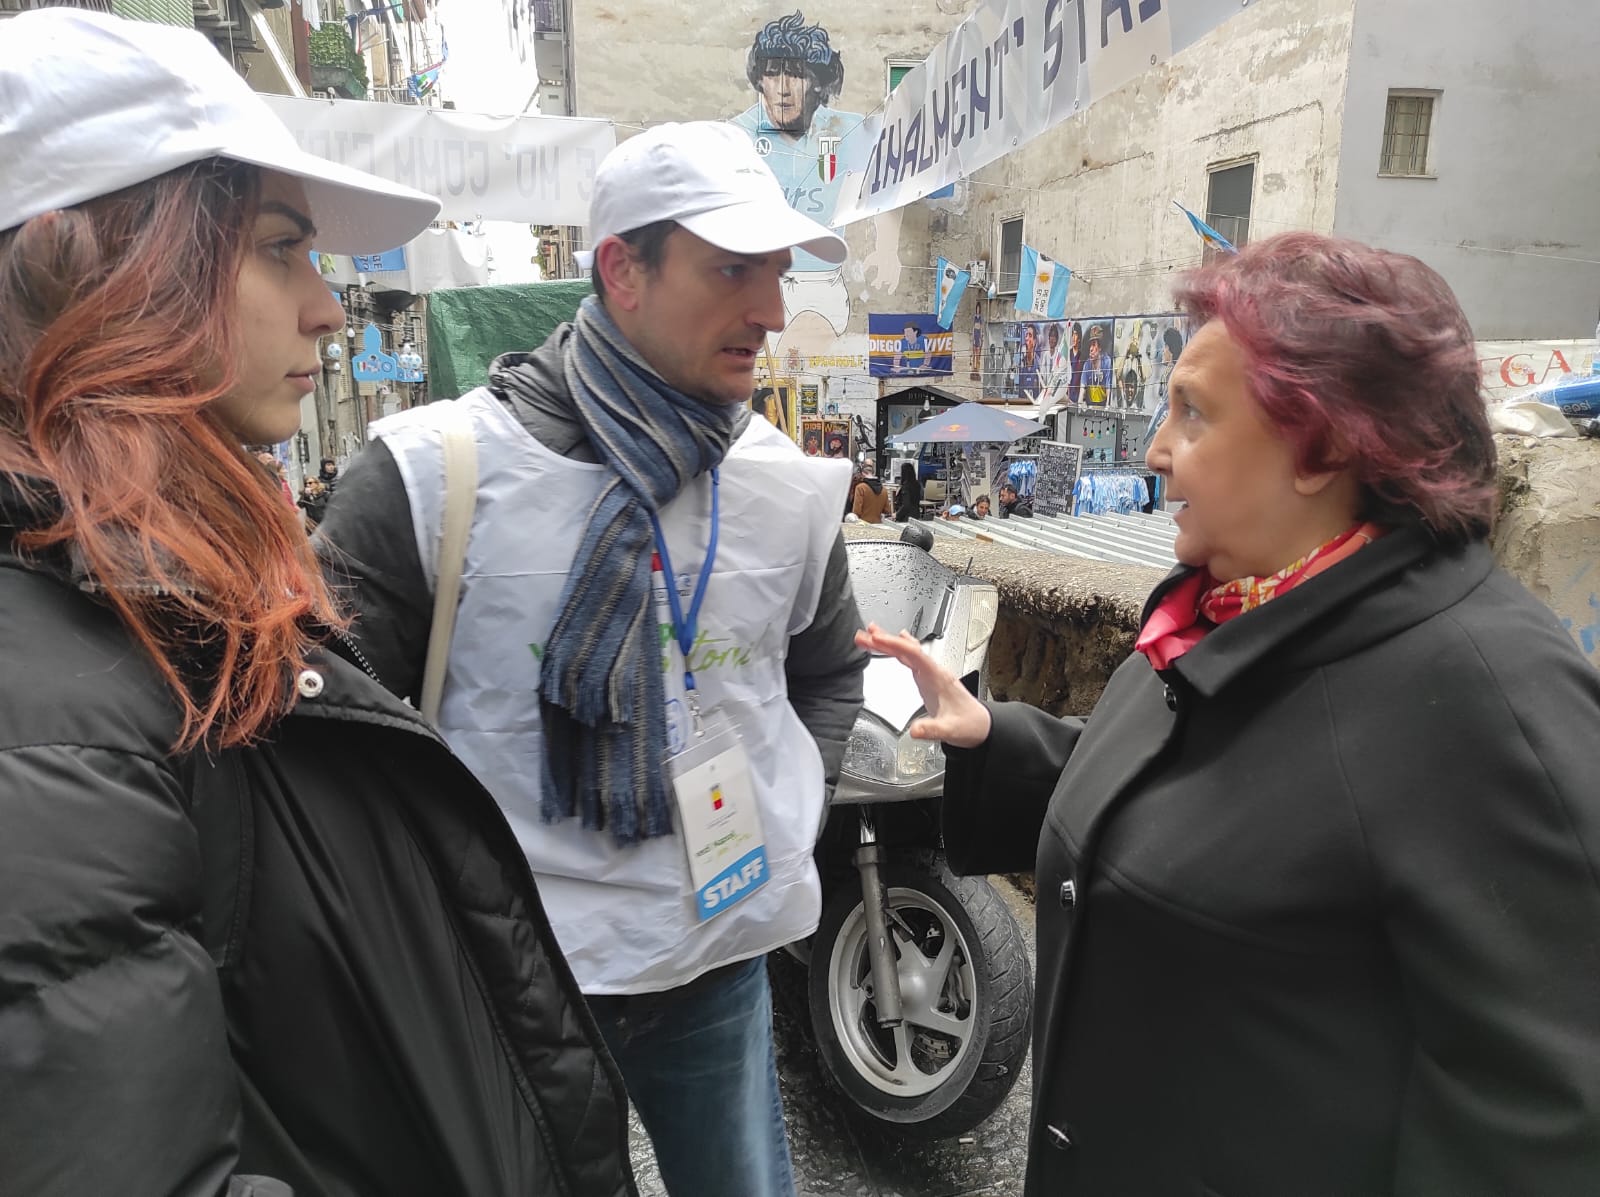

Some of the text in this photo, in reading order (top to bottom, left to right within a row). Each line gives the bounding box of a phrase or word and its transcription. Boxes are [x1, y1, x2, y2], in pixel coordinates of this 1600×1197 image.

[869, 336, 953, 353] DIEGO VIVE
[1561, 401, 1591, 413] epsi
[703, 856, 764, 909] STAFF
